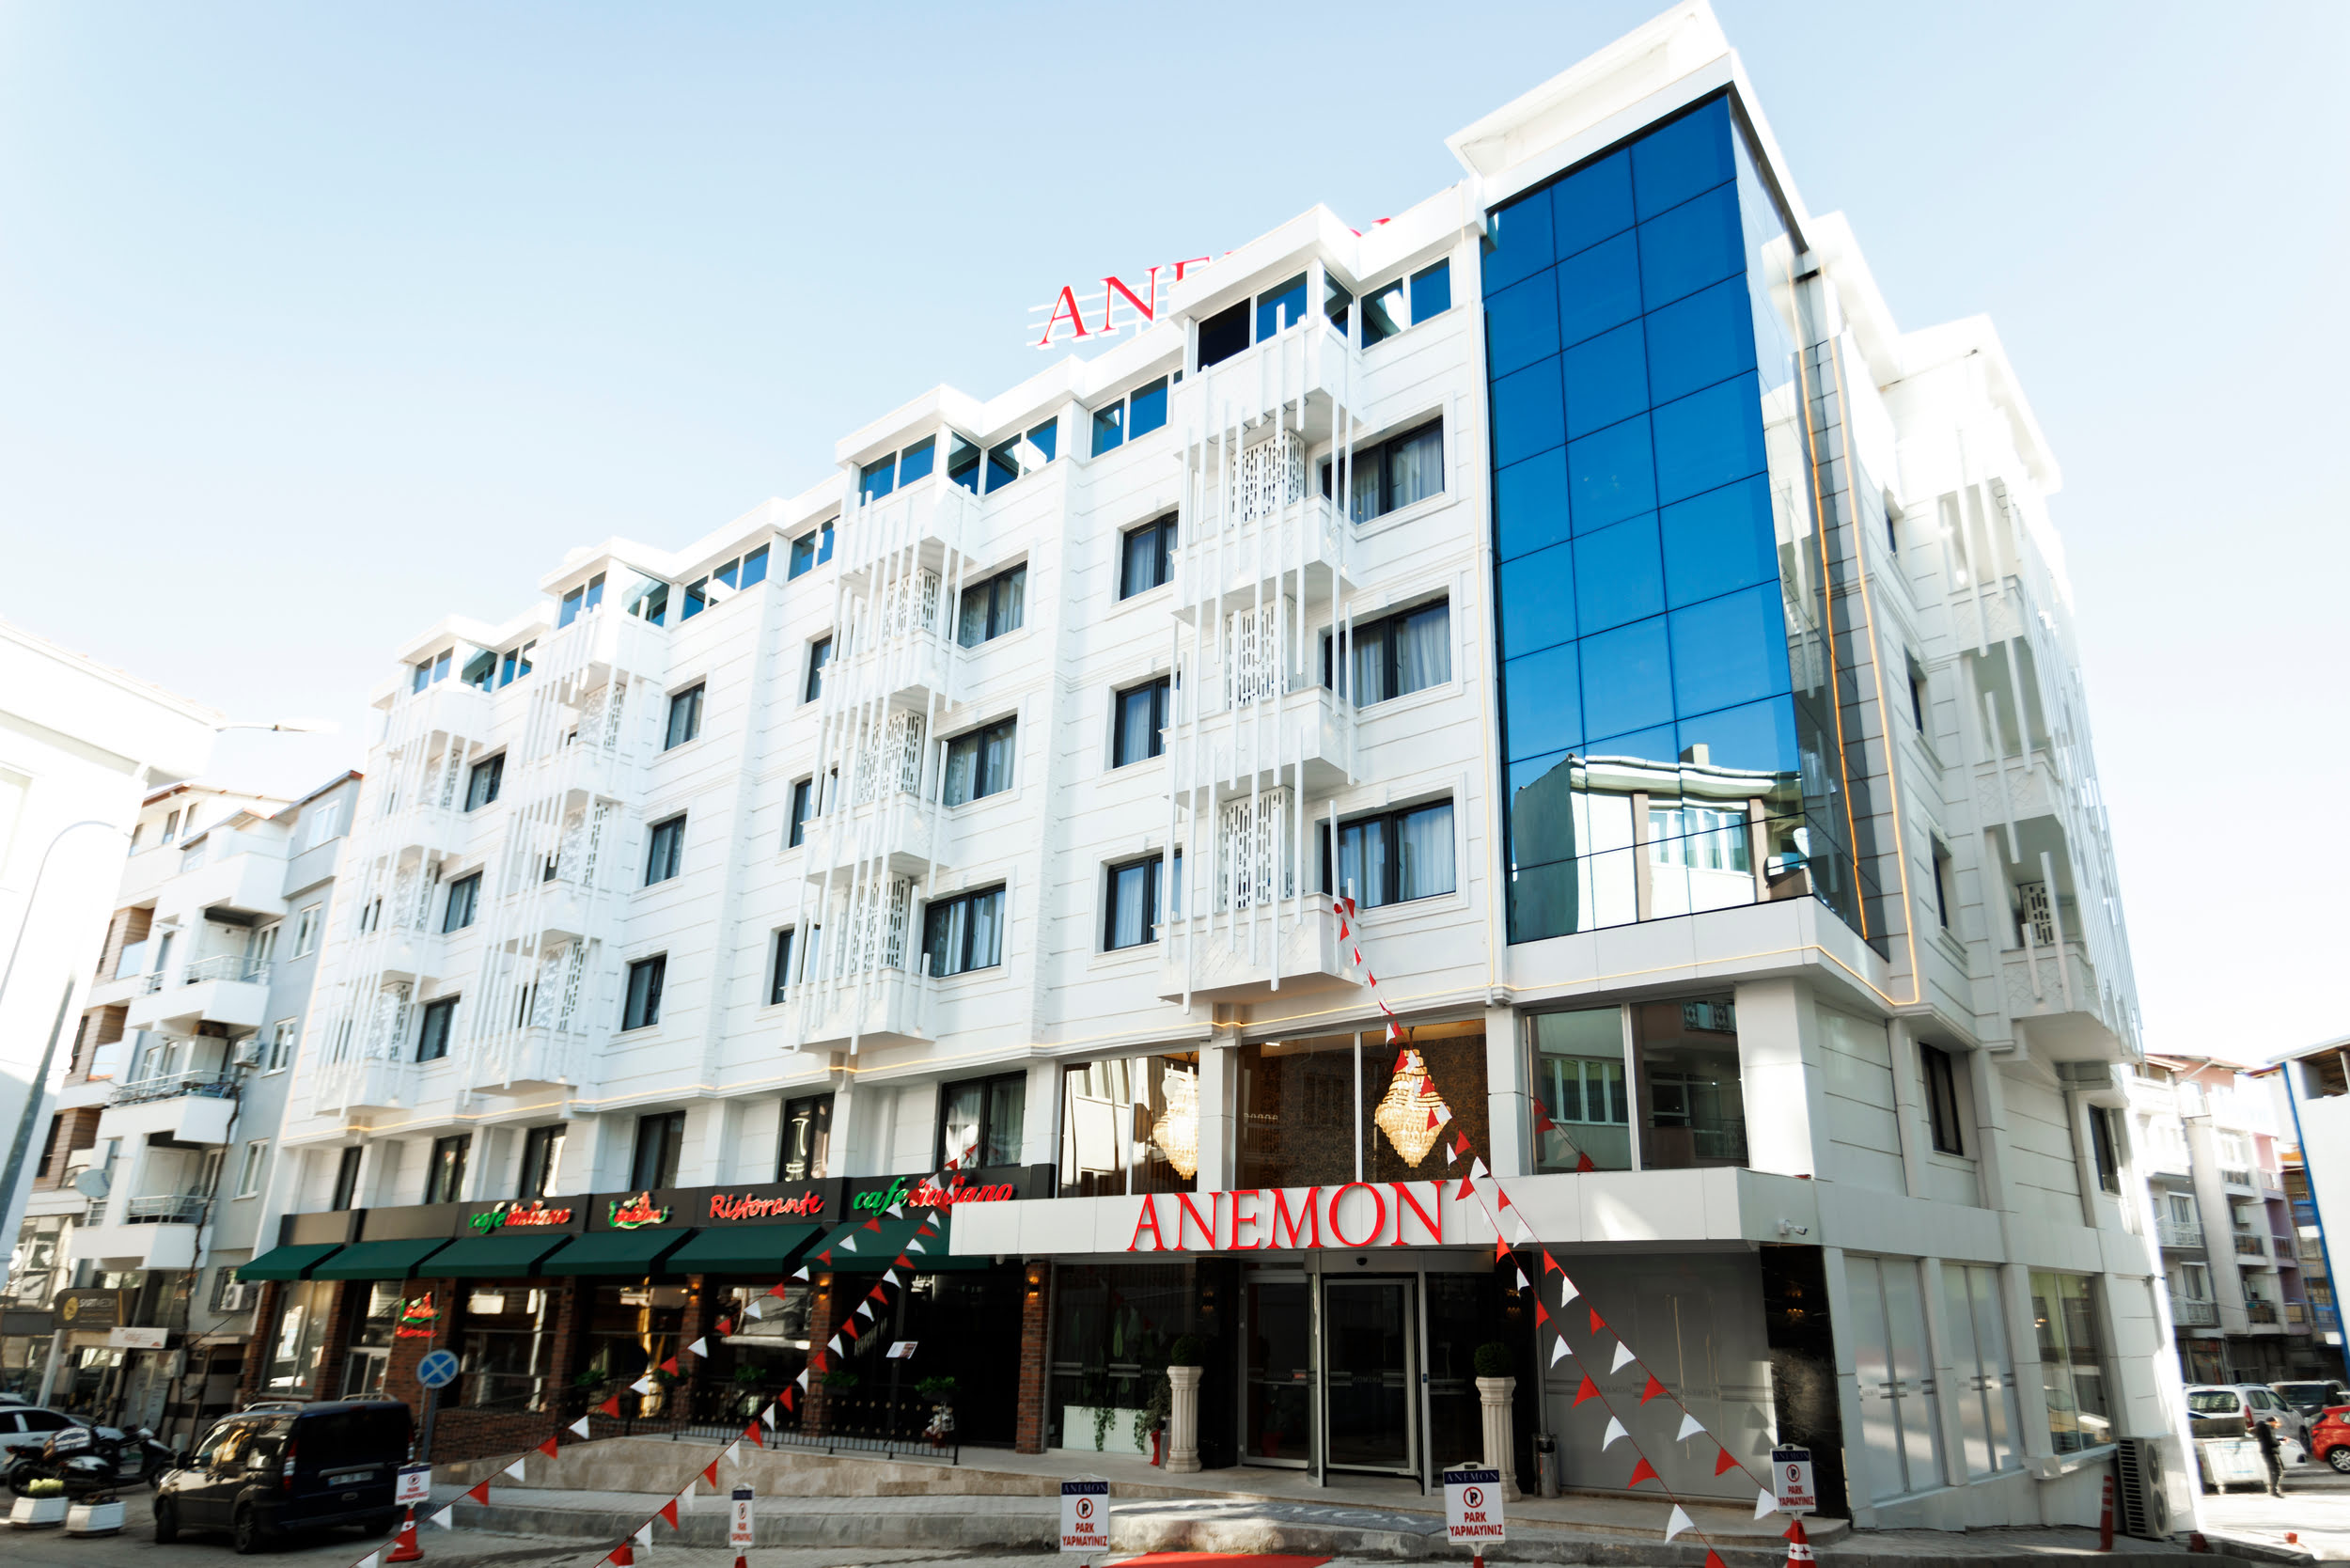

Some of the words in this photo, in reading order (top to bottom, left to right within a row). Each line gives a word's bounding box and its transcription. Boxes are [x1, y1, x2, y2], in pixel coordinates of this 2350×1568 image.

[853, 1176, 909, 1216] cafe
[710, 1190, 824, 1221] Ristorante
[1126, 1180, 1448, 1251] ANEMON
[1447, 1472, 1498, 1482] ANEMON
[1063, 1483, 1107, 1493] ANEMON
[1788, 1485, 1804, 1495] PARK
[1778, 1496, 1815, 1506] YAPMAYINIZ
[1464, 1512, 1487, 1523] PARK
[1075, 1523, 1095, 1533] PARK
[1449, 1524, 1504, 1537] YAPMAYINIZ
[1062, 1535, 1107, 1546] YAPMAYINIZ
